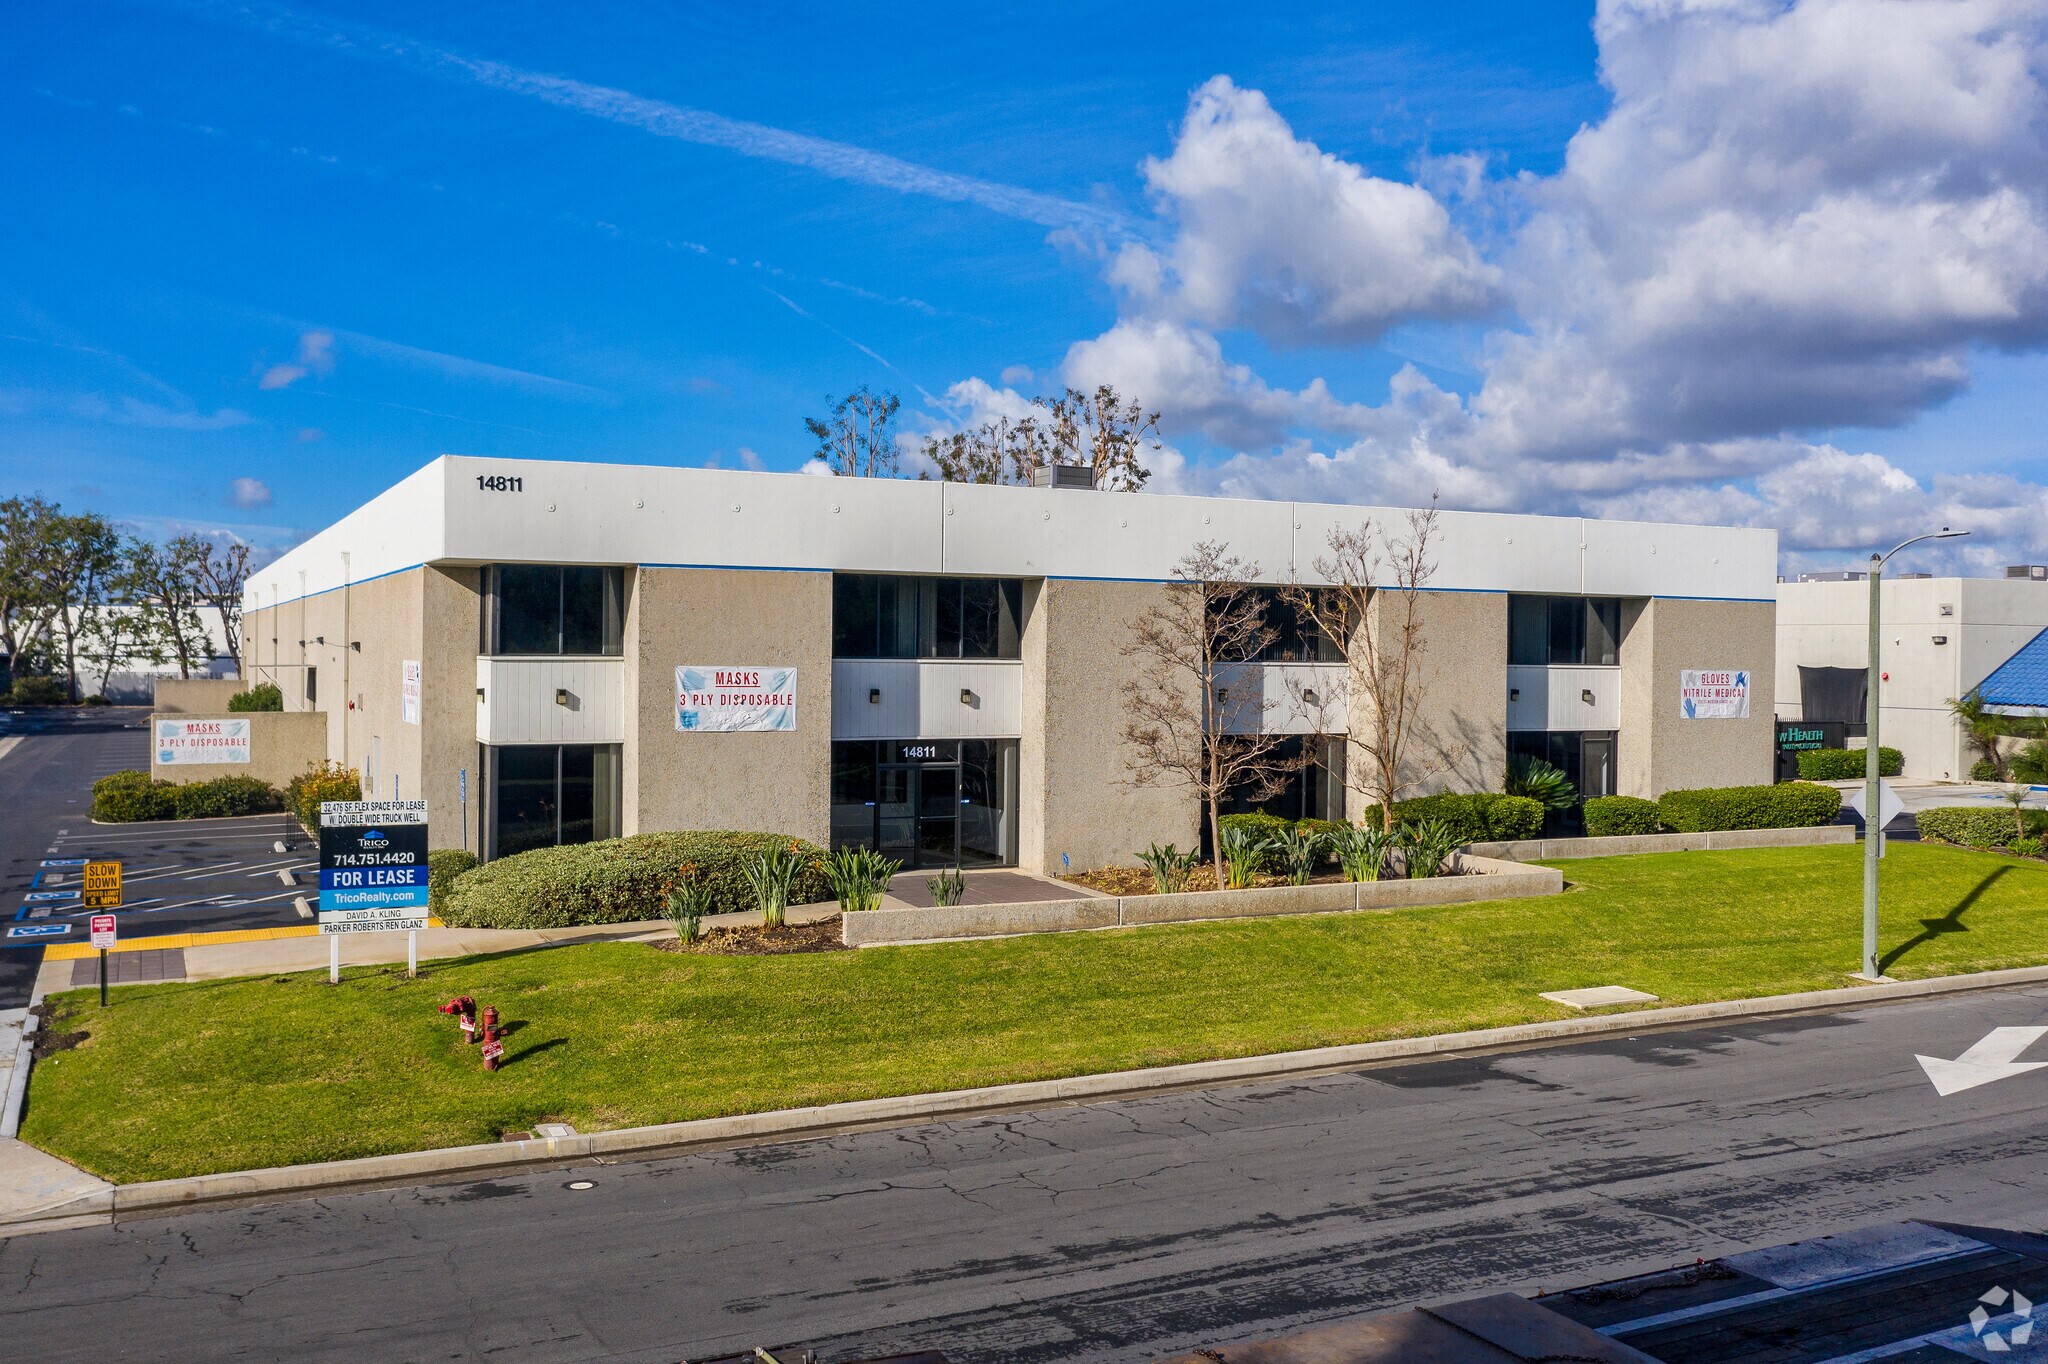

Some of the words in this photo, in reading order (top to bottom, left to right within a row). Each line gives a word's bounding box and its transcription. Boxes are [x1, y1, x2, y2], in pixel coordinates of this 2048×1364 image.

[476, 475, 523, 492] 14811
[715, 672, 759, 685] MASKS
[1701, 673, 1730, 684] GLOVES
[1683, 688, 1712, 698] NITRILE
[1715, 688, 1745, 698] MEDICAL
[680, 694, 686, 705] 3
[693, 694, 714, 705] PLY
[720, 694, 793, 705] DISPOSABLE
[187, 723, 221, 733] MASKS
[160, 739, 165, 747] 3
[169, 738, 186, 747] PLY
[190, 737, 247, 747] DISPOSABLE
[903, 746, 936, 758] 14811
[354, 802, 369, 811] FLEX
[371, 801, 390, 811] SPACE
[392, 801, 404, 811] FOR
[406, 800, 425, 810] LEASE
[338, 814, 363, 824] DOUBLE
[364, 814, 380, 824] WIDE
[382, 813, 402, 823] TRUCK
[404, 813, 420, 822] WELL
[334, 852, 415, 866] 714.751.4420
[89, 865, 116, 876] SLOW
[88, 877, 117, 888] DOWN
[333, 872, 362, 887] FOR
[368, 869, 415, 885] LEASE
[90, 897, 97, 905] 5
[100, 896, 119, 905] MPH
[334, 891, 415, 904] TricoRealty.com
[346, 911, 368, 920] DAVID
[370, 911, 378, 919] A.
[379, 910, 401, 918] KLING
[324, 923, 351, 933] PARKER
[400, 920, 423, 930] GLANZ
